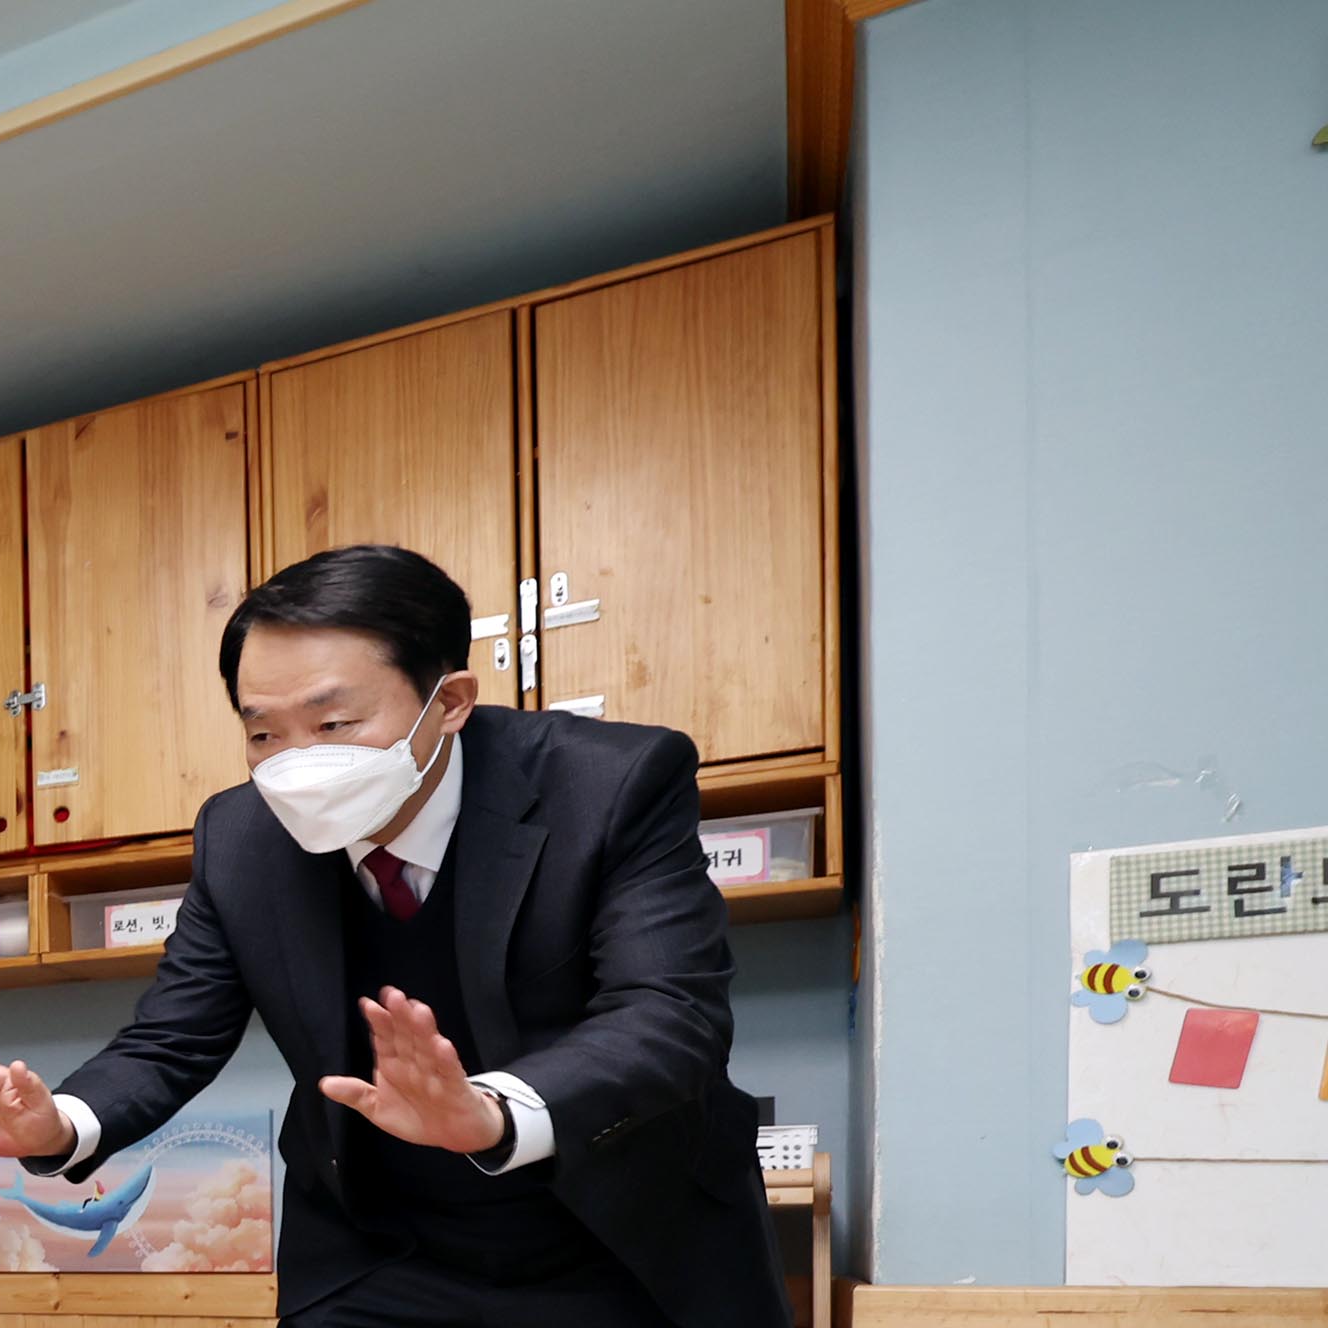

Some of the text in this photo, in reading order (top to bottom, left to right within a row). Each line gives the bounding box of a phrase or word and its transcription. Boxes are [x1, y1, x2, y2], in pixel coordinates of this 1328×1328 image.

[706, 847, 743, 869] 저귀
[1139, 855, 1328, 919] 도란
[112, 915, 171, 933] 로션, 빗,
